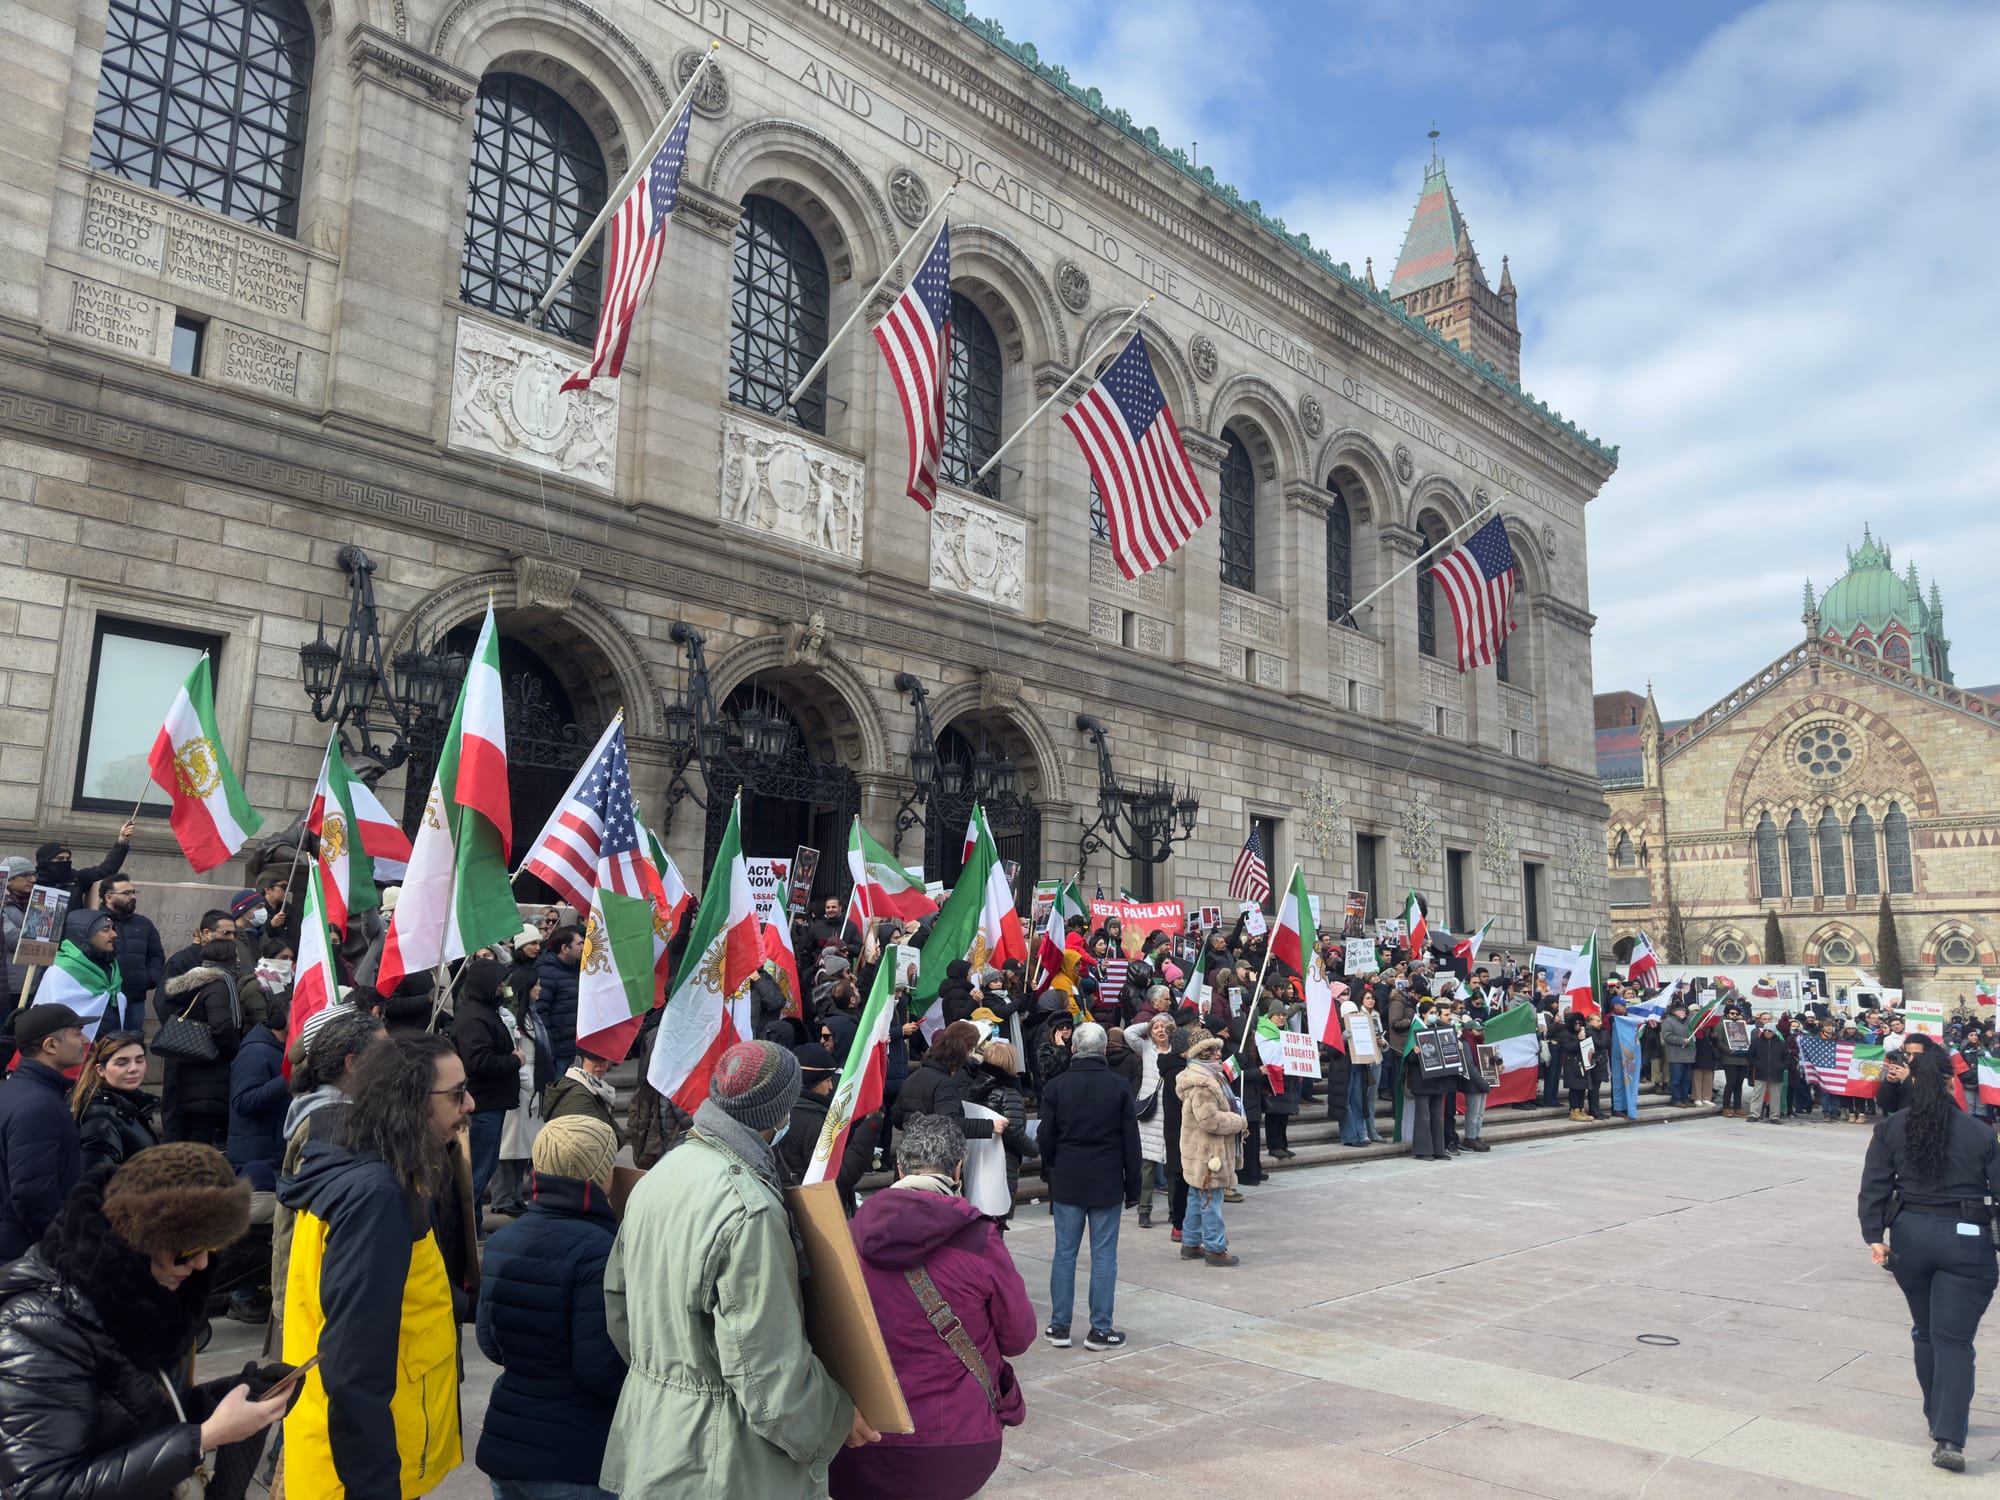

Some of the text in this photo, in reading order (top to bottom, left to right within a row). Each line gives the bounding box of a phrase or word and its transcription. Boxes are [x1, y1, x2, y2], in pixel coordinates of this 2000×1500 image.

[90, 198, 153, 228] PERSEVS
[92, 186, 158, 216] APELLES
[86, 225, 138, 250] GVIDO
[88, 212, 149, 240] GIOTTO
[173, 214, 235, 243] RAPHAEL
[85, 238, 160, 271] GIORGIONE
[242, 239, 289, 263] DVRER
[800, 61, 872, 117] AND
[902, 115, 1063, 230] DEDICATED
[1086, 225, 1119, 262] TO
[1135, 253, 1180, 300] THE
[1192, 292, 1330, 385] ADVANCEMENT
[1342, 377, 1365, 401] OF
[1375, 394, 1447, 450] LEARNING
[168, 264, 229, 293] VERONESE
[170, 252, 230, 281] TINTORETTO
[79, 283, 149, 313] MVRILLO
[235, 289, 288, 314] MATSYS
[237, 275, 298, 305] VAN DYCK
[77, 296, 131, 320] RVBENS
[74, 321, 138, 350] HOLBEIN
[75, 308, 151, 338] REMBRANDT
[229, 343, 295, 369] CORREGGIO
[231, 330, 286, 355] POVSSIN
[226, 366, 293, 394] SANSOVINO
[747, 866, 770, 876] ACT
[1093, 903, 1181, 919] REZA PAHLAVI
[1284, 1046, 1316, 1060] SLAUGHTER
[1286, 1033, 1312, 1046] STOP THE
[1292, 1061, 1313, 1073] IN IRAN
